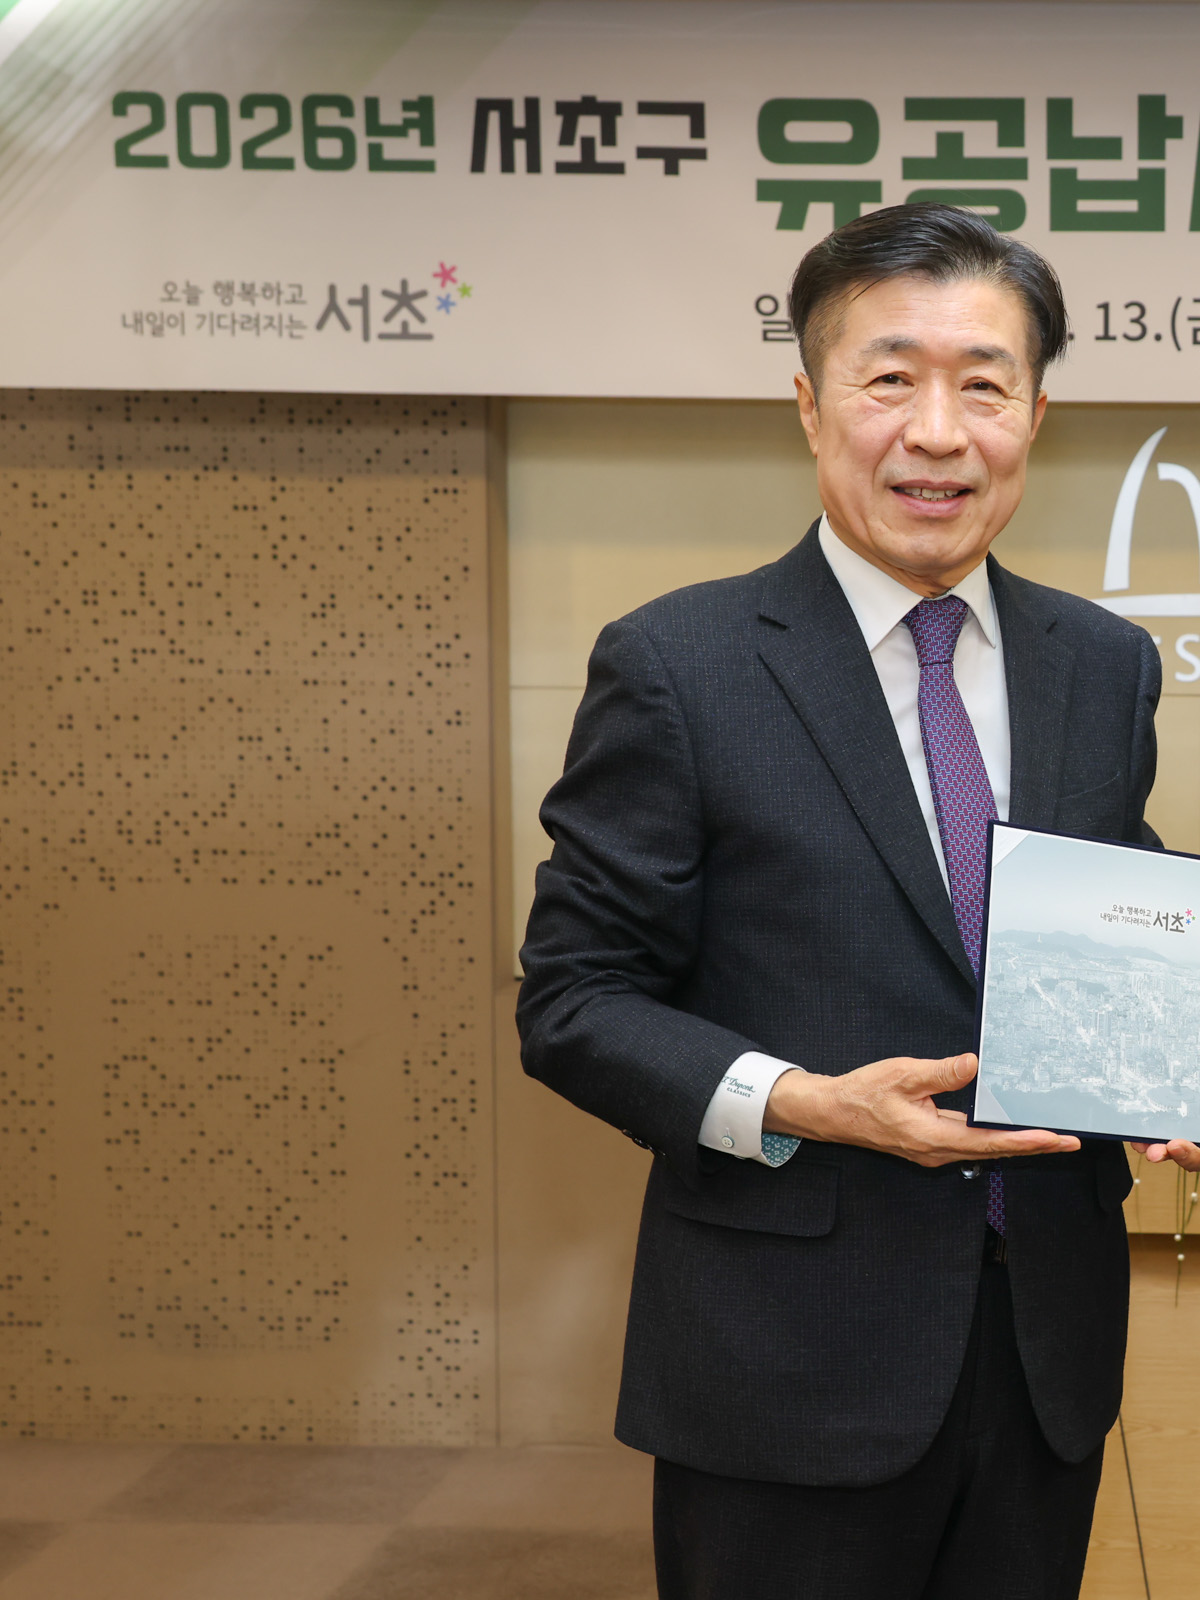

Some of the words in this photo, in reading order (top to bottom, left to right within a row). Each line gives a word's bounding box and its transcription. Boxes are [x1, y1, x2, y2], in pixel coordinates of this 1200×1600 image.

[111, 91, 436, 172] 2026년
[470, 95, 707, 176] 서초구
[160, 280, 202, 306] 오늘
[213, 281, 306, 306] 행복하고
[315, 279, 434, 342] 서초
[122, 312, 185, 337] 내일이
[196, 312, 307, 339] 기다려지는
[1100, 913, 1119, 923] 내일이
[1121, 916, 1152, 928] 기다려지는
[1112, 904, 1124, 914] 오늘
[1127, 906, 1152, 917] 행복하고
[1153, 910, 1185, 934] 서초
[727, 1087, 751, 1098] CLASSICS
